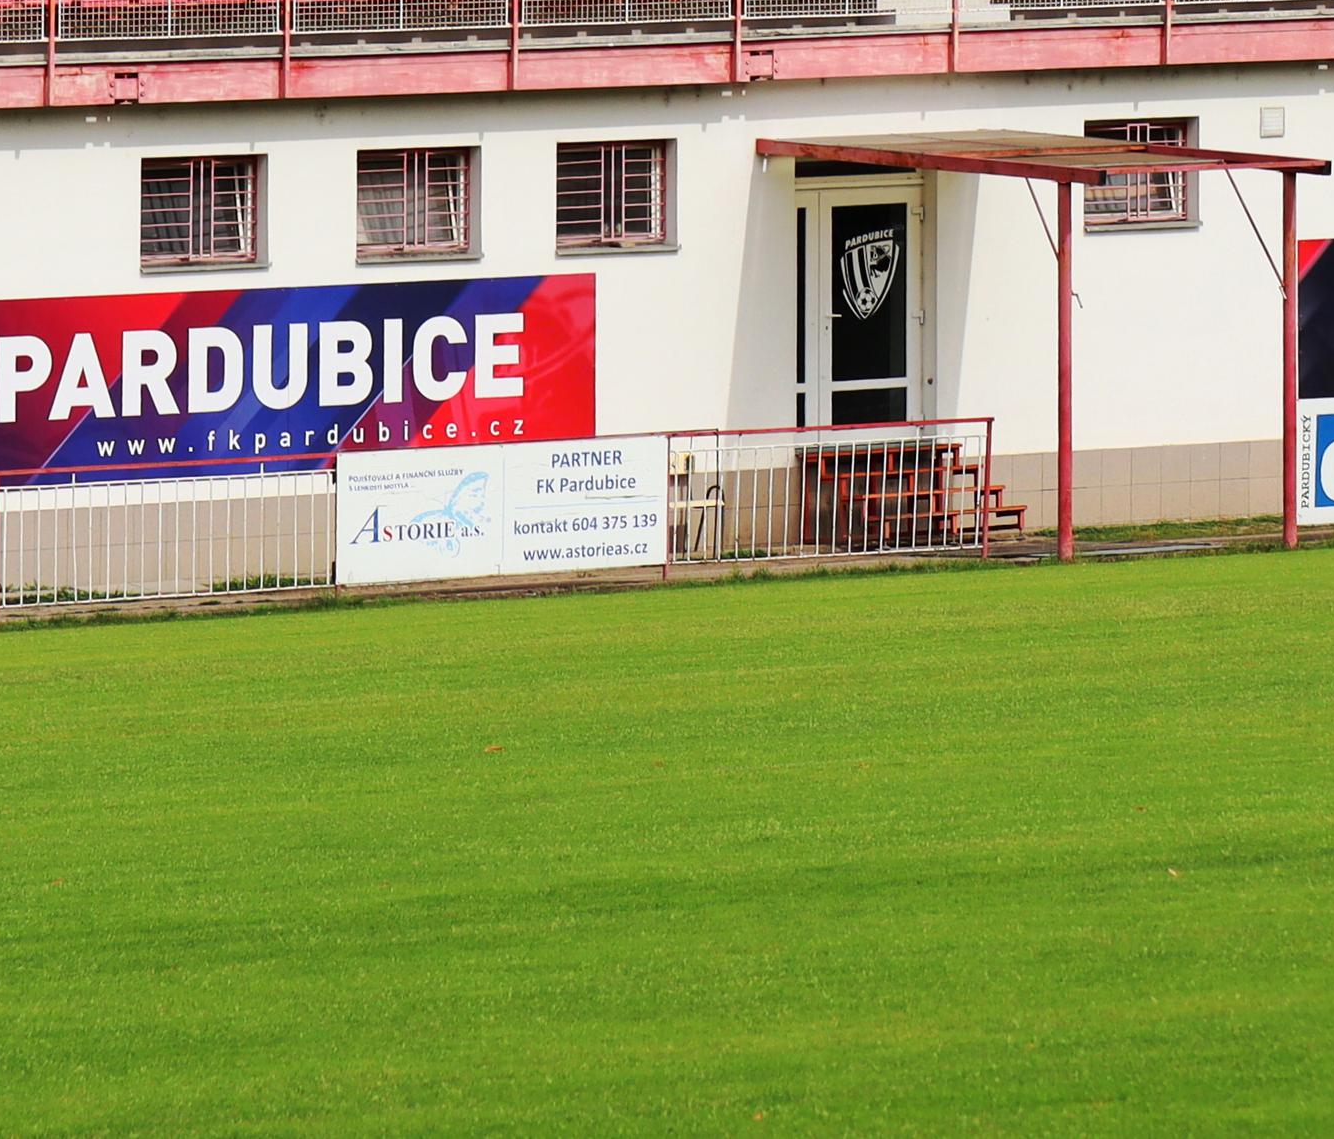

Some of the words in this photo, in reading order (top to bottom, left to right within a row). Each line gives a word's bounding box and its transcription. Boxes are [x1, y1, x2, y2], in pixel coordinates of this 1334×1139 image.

[845, 228, 894, 250] PARDUBICE
[96, 418, 525, 458] www.fkpardubice.cz
[552, 450, 622, 468] PARTNER
[1300, 414, 1312, 508] PARDUBICKÝ
[537, 479, 555, 494] FK
[559, 474, 637, 493] Pardubice
[461, 526, 484, 538] a.s.
[514, 519, 568, 535] kontakt
[572, 517, 598, 531] 604
[602, 515, 627, 529] 375
[633, 513, 658, 528] 139
[523, 542, 648, 561] www.astorieas.cz
